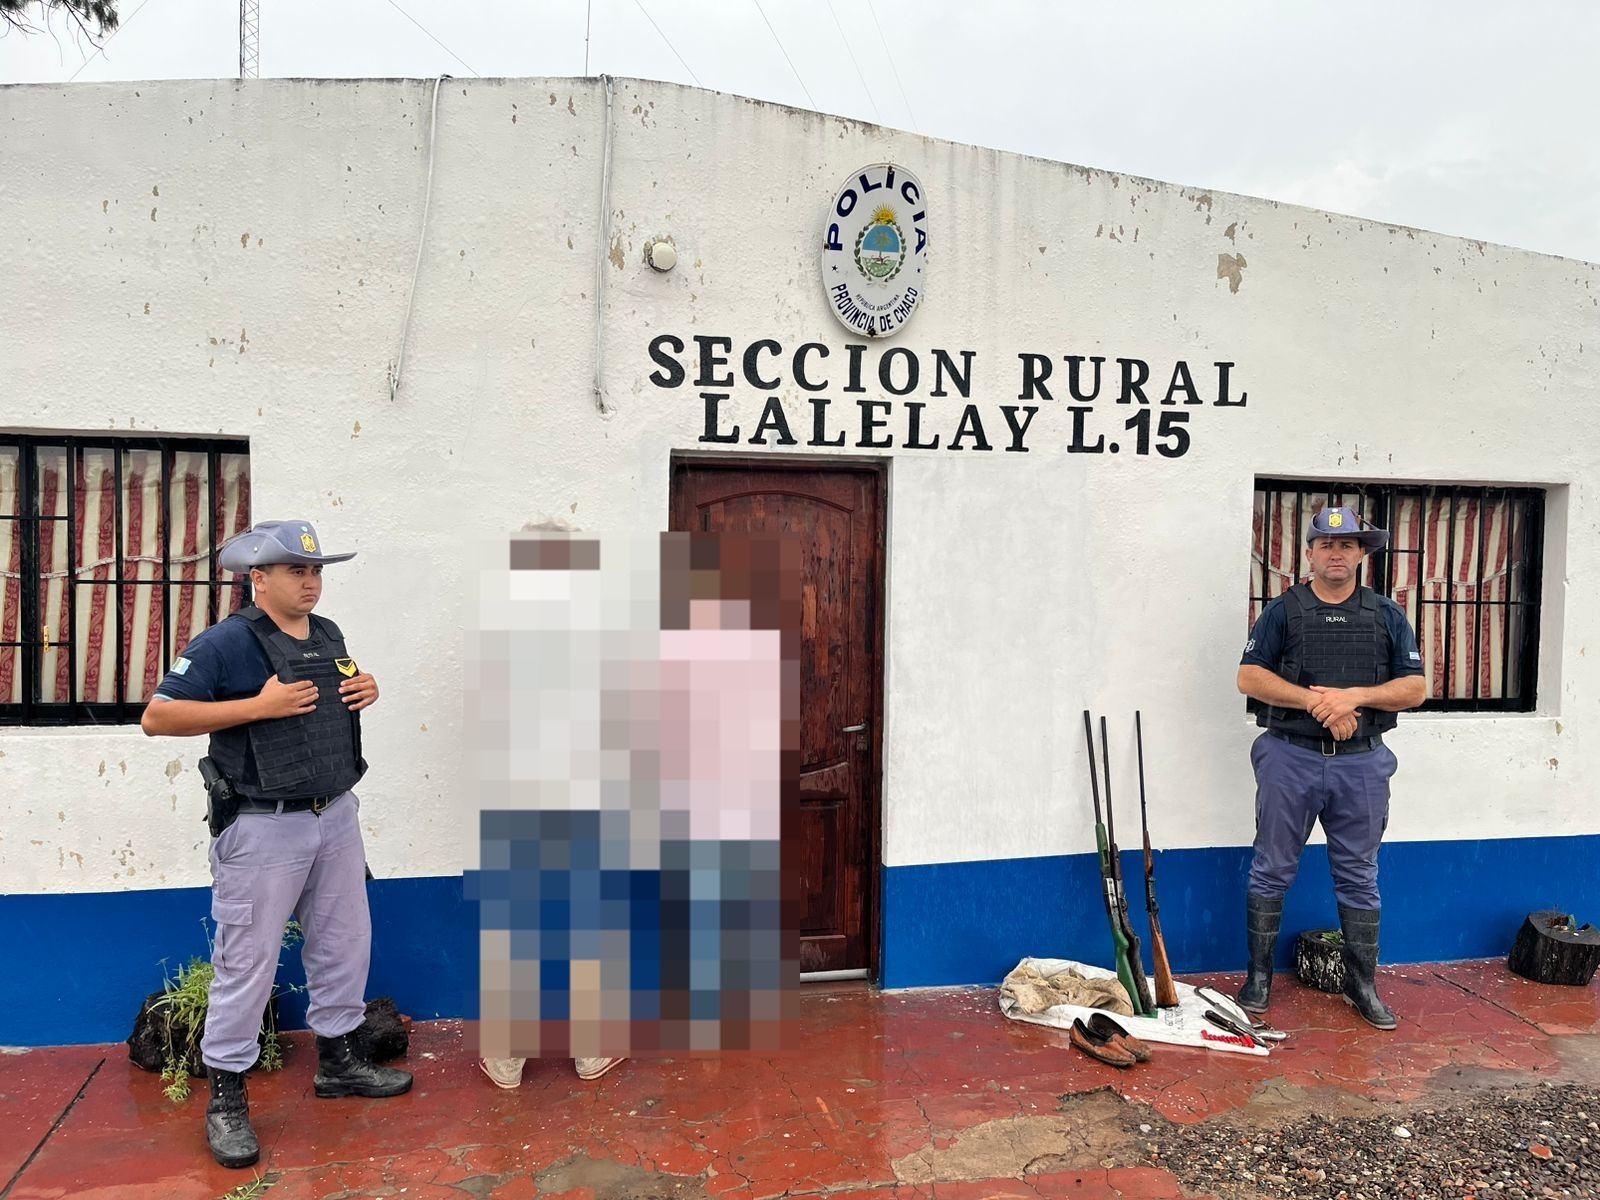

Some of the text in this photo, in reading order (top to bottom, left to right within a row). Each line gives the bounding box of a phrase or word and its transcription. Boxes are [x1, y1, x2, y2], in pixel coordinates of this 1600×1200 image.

[827, 170, 926, 255] POLICIA
[831, 283, 918, 332] PROVINCIA DE CHACO
[649, 335, 1247, 407] SECCION RURAL
[699, 393, 1190, 458] LALELAY L.15
